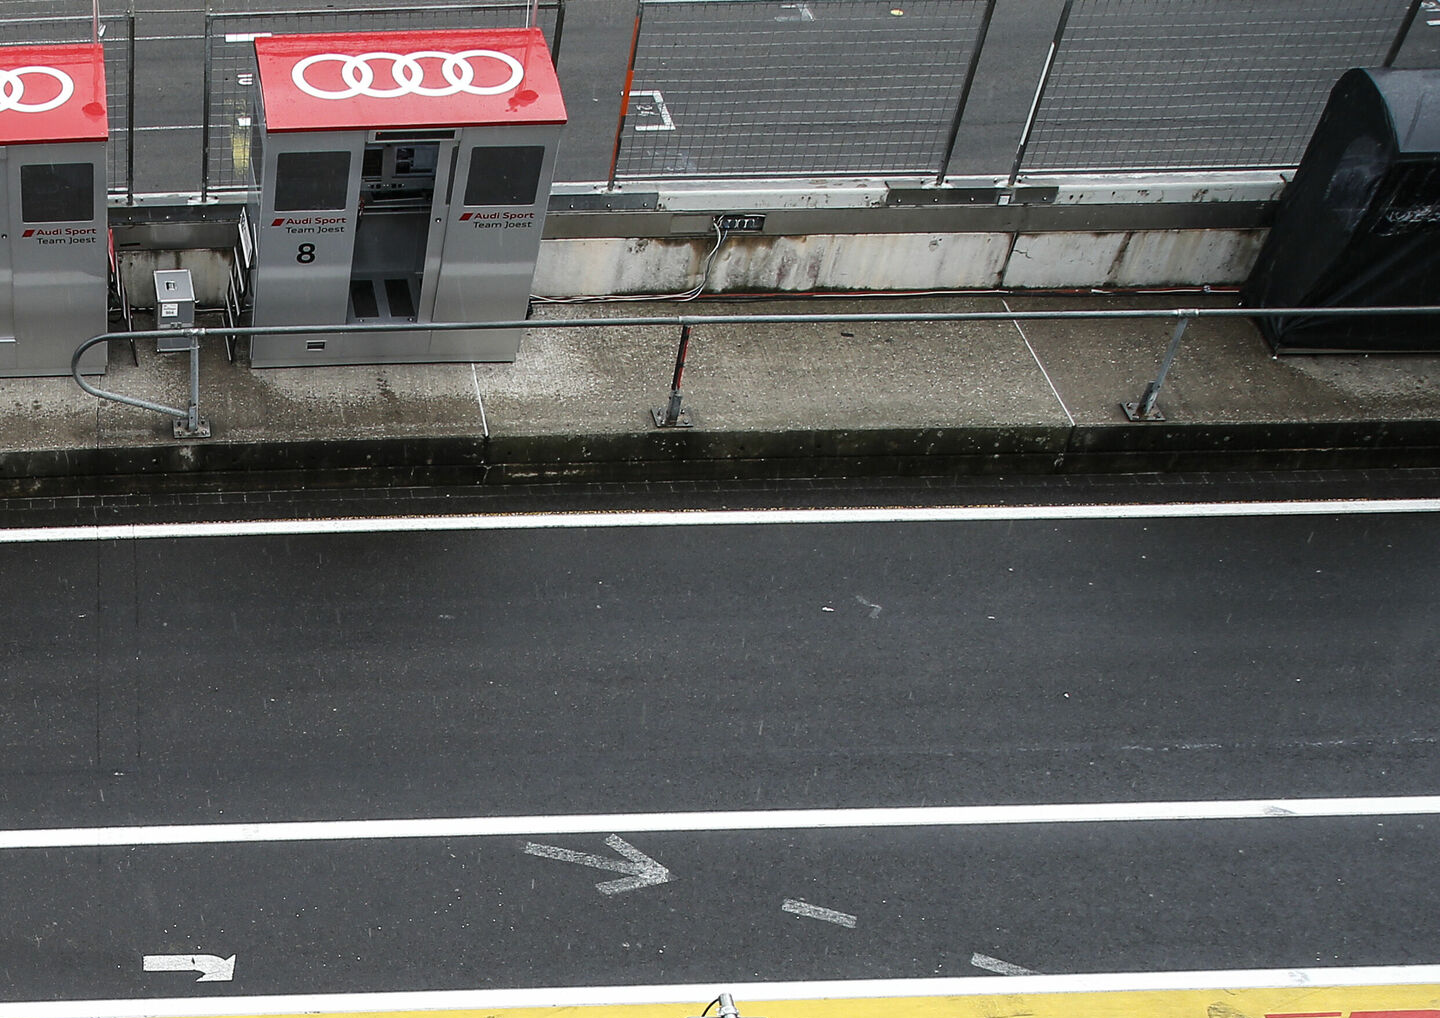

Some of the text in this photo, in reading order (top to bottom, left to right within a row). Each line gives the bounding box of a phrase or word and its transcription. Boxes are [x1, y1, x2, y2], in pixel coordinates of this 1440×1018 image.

[286, 216, 347, 226] Audi Sport
[474, 211, 535, 221] Audi Sport
[504, 220, 532, 229] Joest
[65, 227, 97, 237] Sport
[317, 226, 345, 234] Joest
[37, 236, 96, 245] Team Joest
[296, 242, 316, 264] 8
